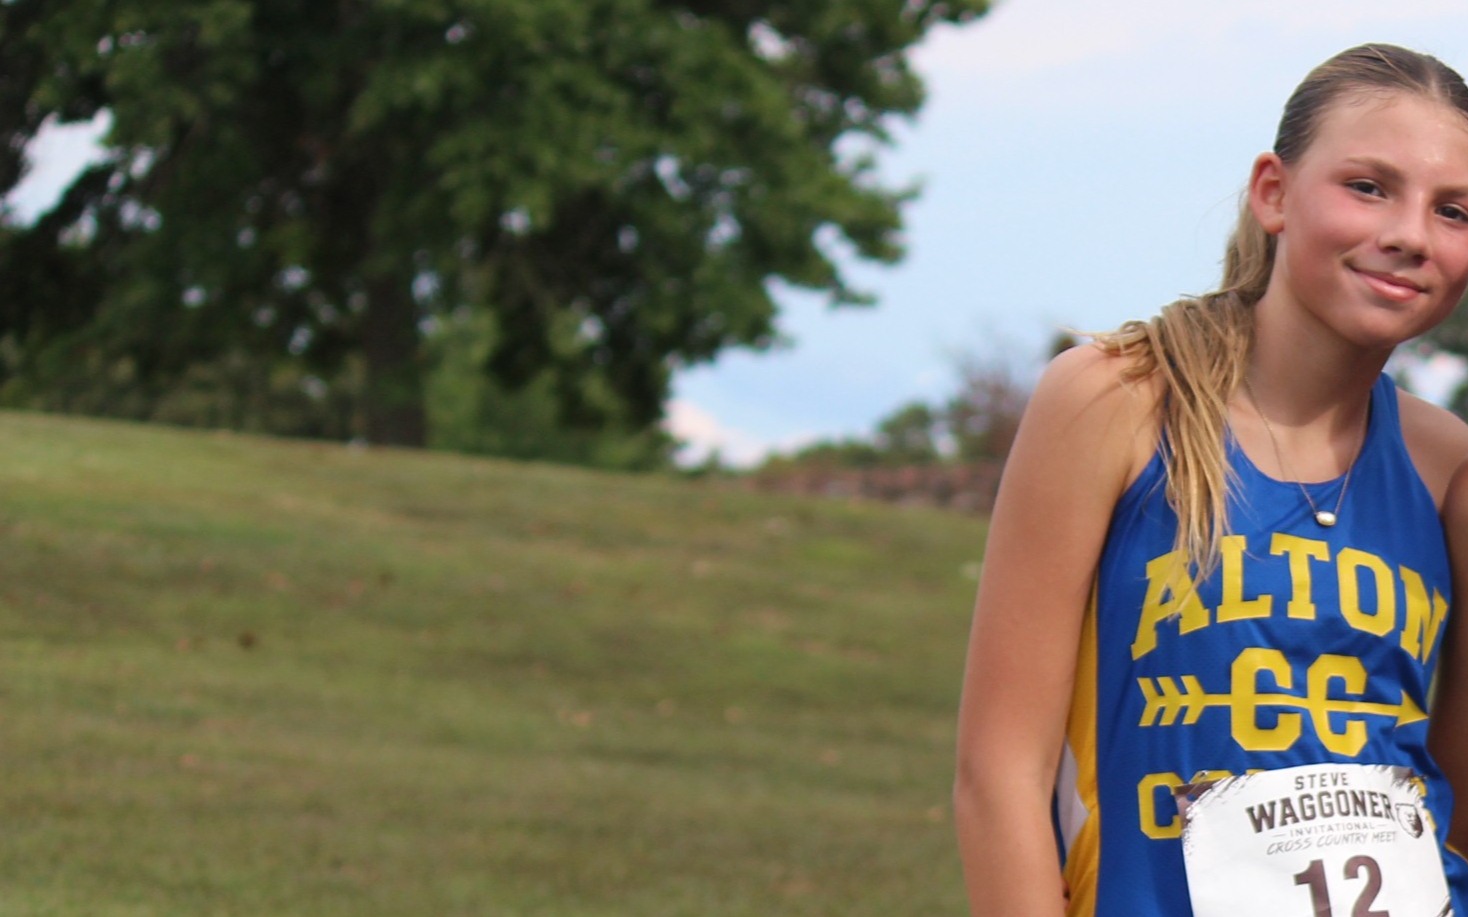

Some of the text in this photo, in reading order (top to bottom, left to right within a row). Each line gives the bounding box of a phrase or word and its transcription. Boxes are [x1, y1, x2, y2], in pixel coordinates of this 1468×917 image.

[1131, 532, 1448, 664] ALTON
[1230, 647, 1369, 758] CC
[1294, 772, 1349, 790] STEVE
[1246, 790, 1396, 833] WAGGONER
[1290, 823, 1375, 837] INVITATIONAL
[1266, 830, 1398, 856] CROSS COUNTRY MEET
[1292, 854, 1391, 917] 12
